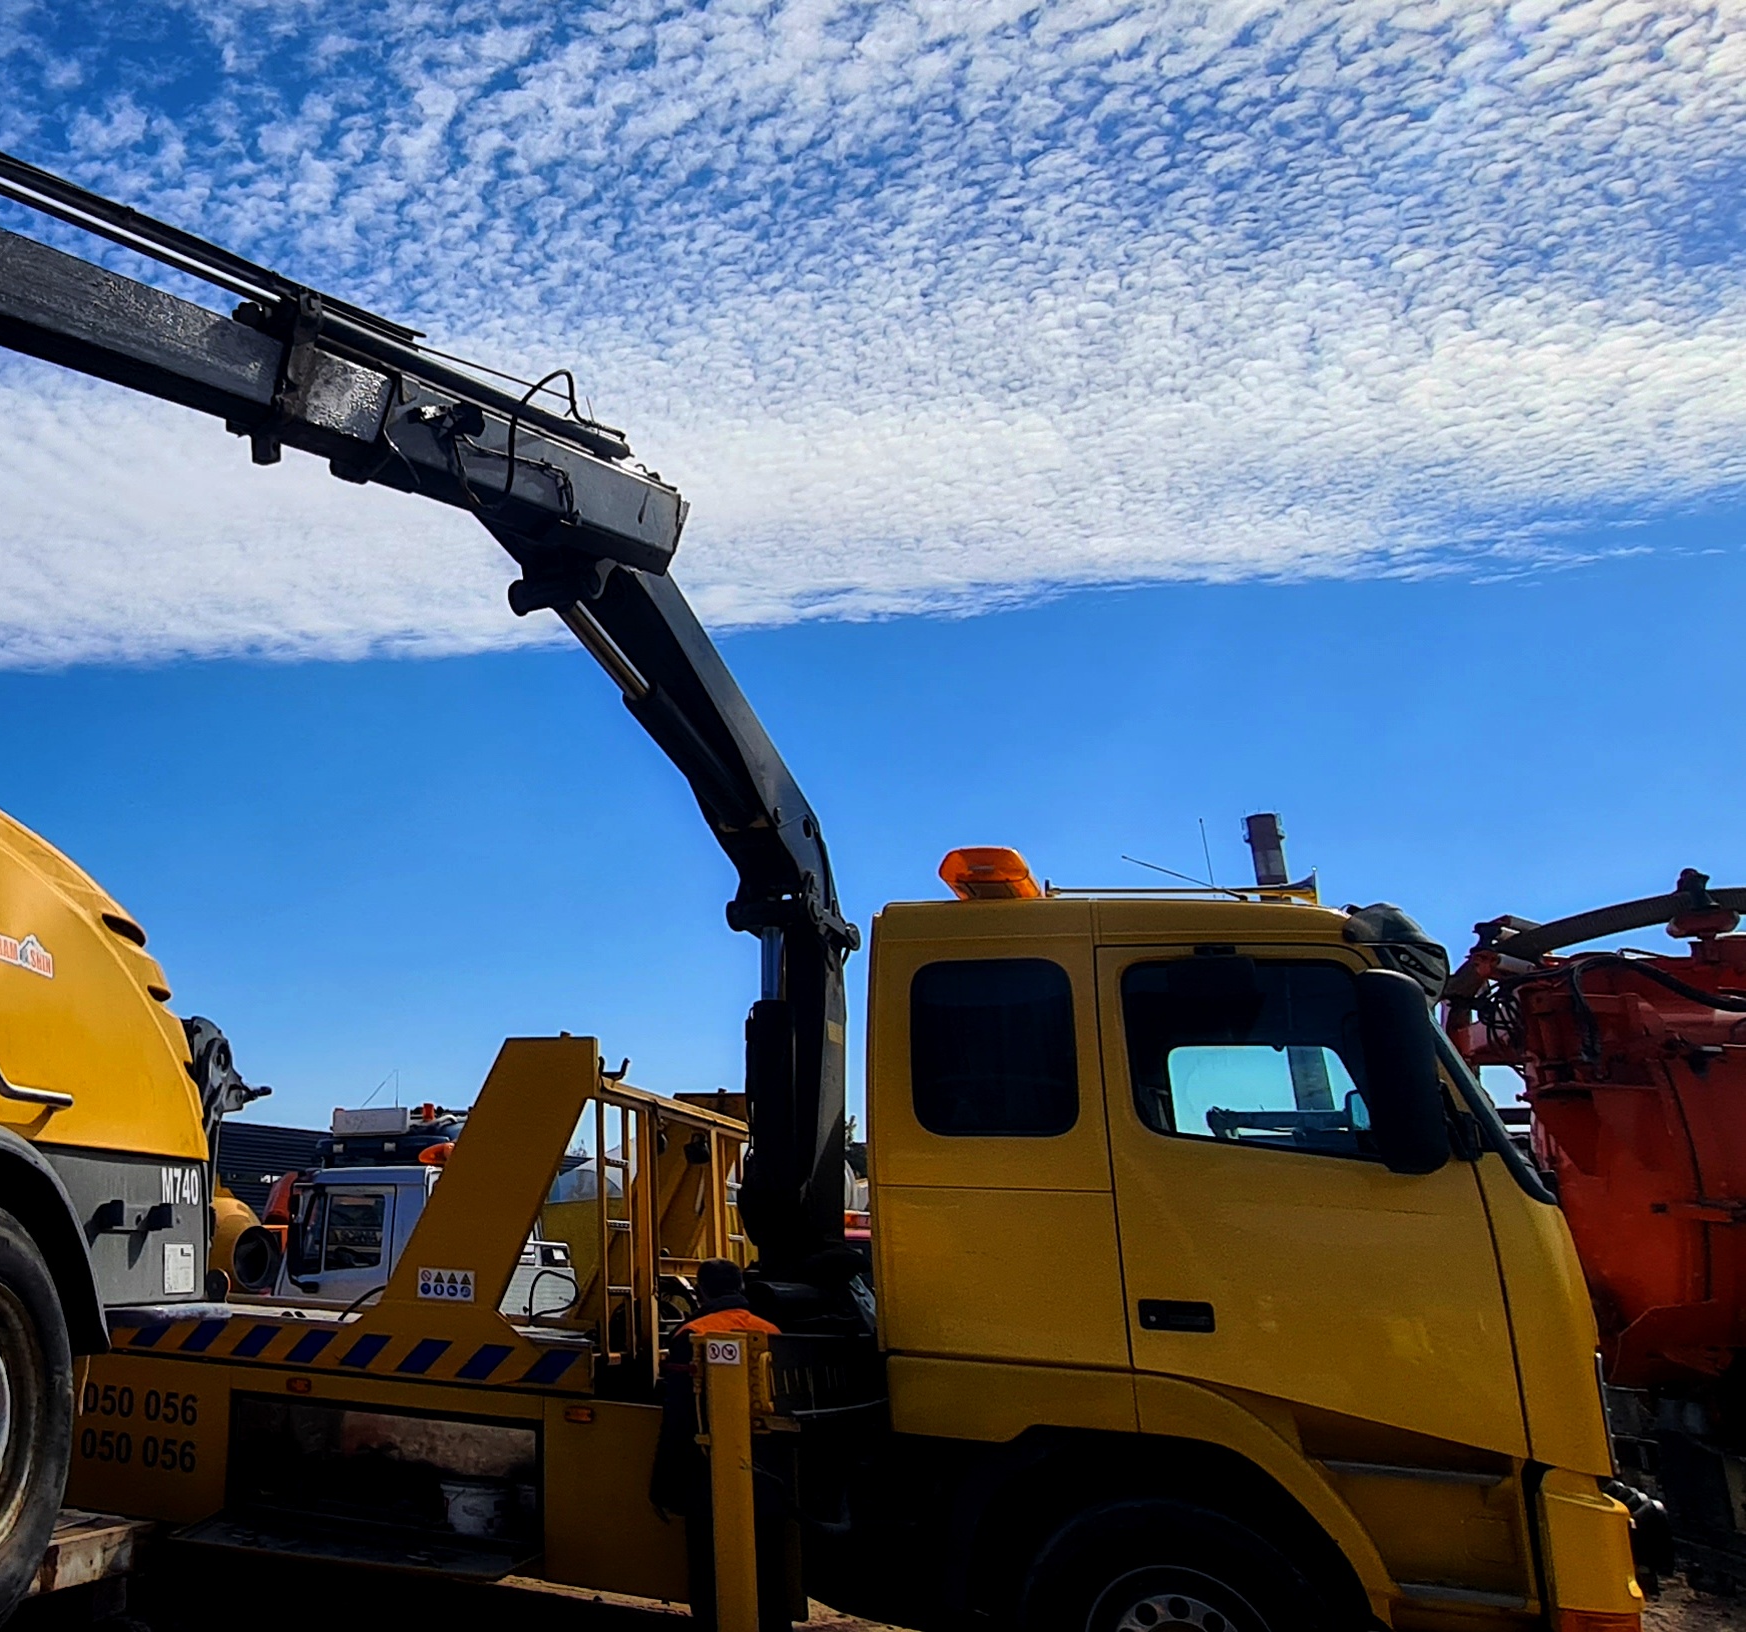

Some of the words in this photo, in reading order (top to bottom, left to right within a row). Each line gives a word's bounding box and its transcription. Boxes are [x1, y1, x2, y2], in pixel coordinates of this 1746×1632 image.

[161, 1167, 199, 1205] M740
[84, 1382, 134, 1418] 050
[144, 1389, 198, 1425] 056
[81, 1428, 132, 1464] 050
[142, 1436, 196, 1473] 056
